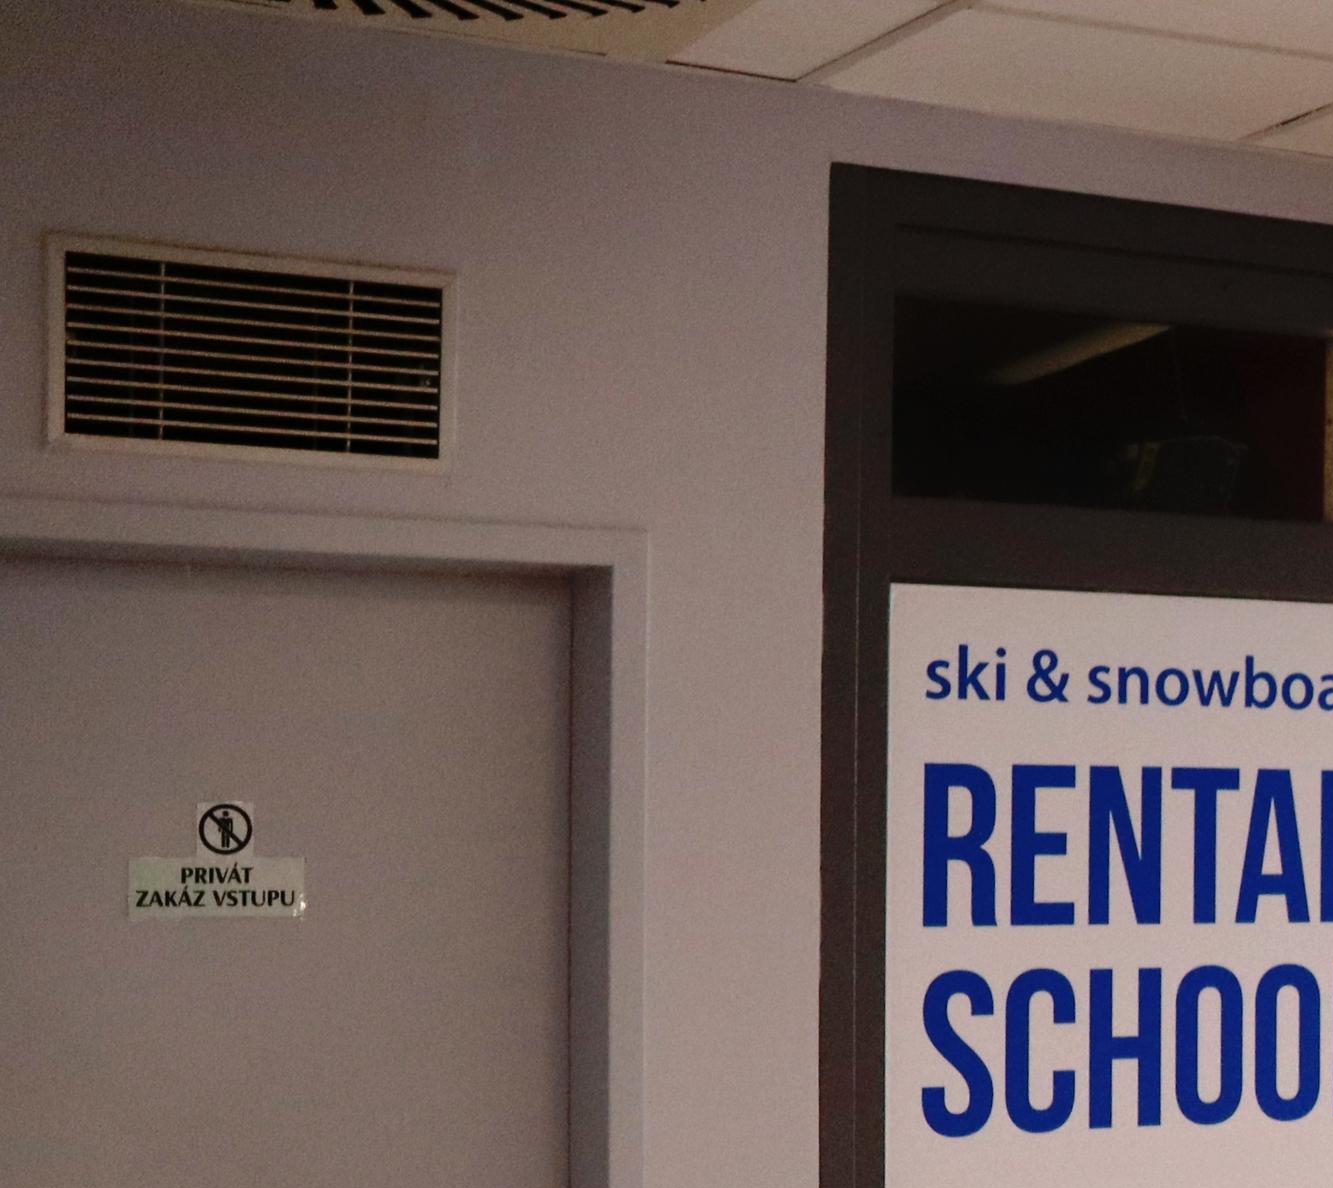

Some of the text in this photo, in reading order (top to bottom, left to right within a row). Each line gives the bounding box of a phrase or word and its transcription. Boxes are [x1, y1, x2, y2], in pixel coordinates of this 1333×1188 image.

[924, 644, 1006, 701] ski
[1026, 648, 1069, 703] &
[181, 862, 253, 884] PRIVÁT
[136, 886, 296, 908] ZAKÁZ VSTUPU
